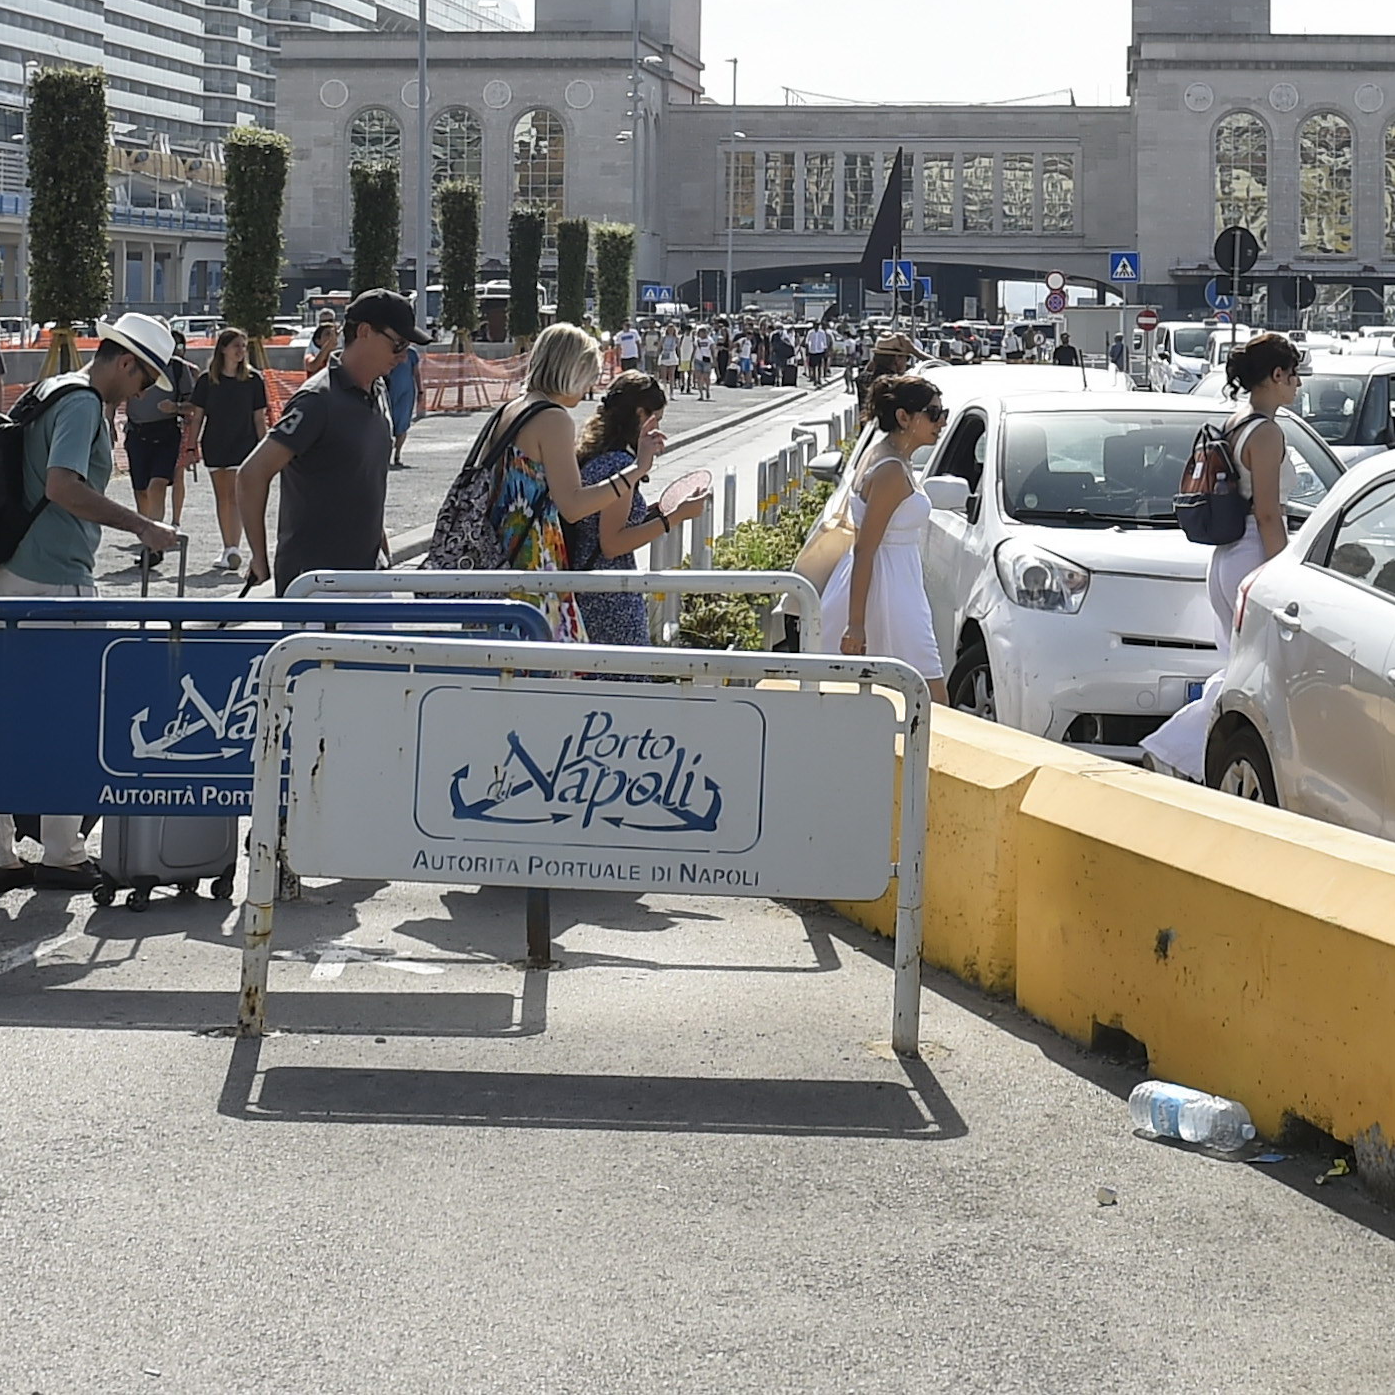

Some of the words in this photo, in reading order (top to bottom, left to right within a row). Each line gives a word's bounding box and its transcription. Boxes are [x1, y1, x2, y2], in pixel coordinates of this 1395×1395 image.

[279, 407, 304, 435] 3
[575, 710, 675, 760] Porto
[504, 729, 703, 830] Napoli
[528, 855, 641, 881] PORTUALE
[679, 862, 760, 887] NAPOLI
